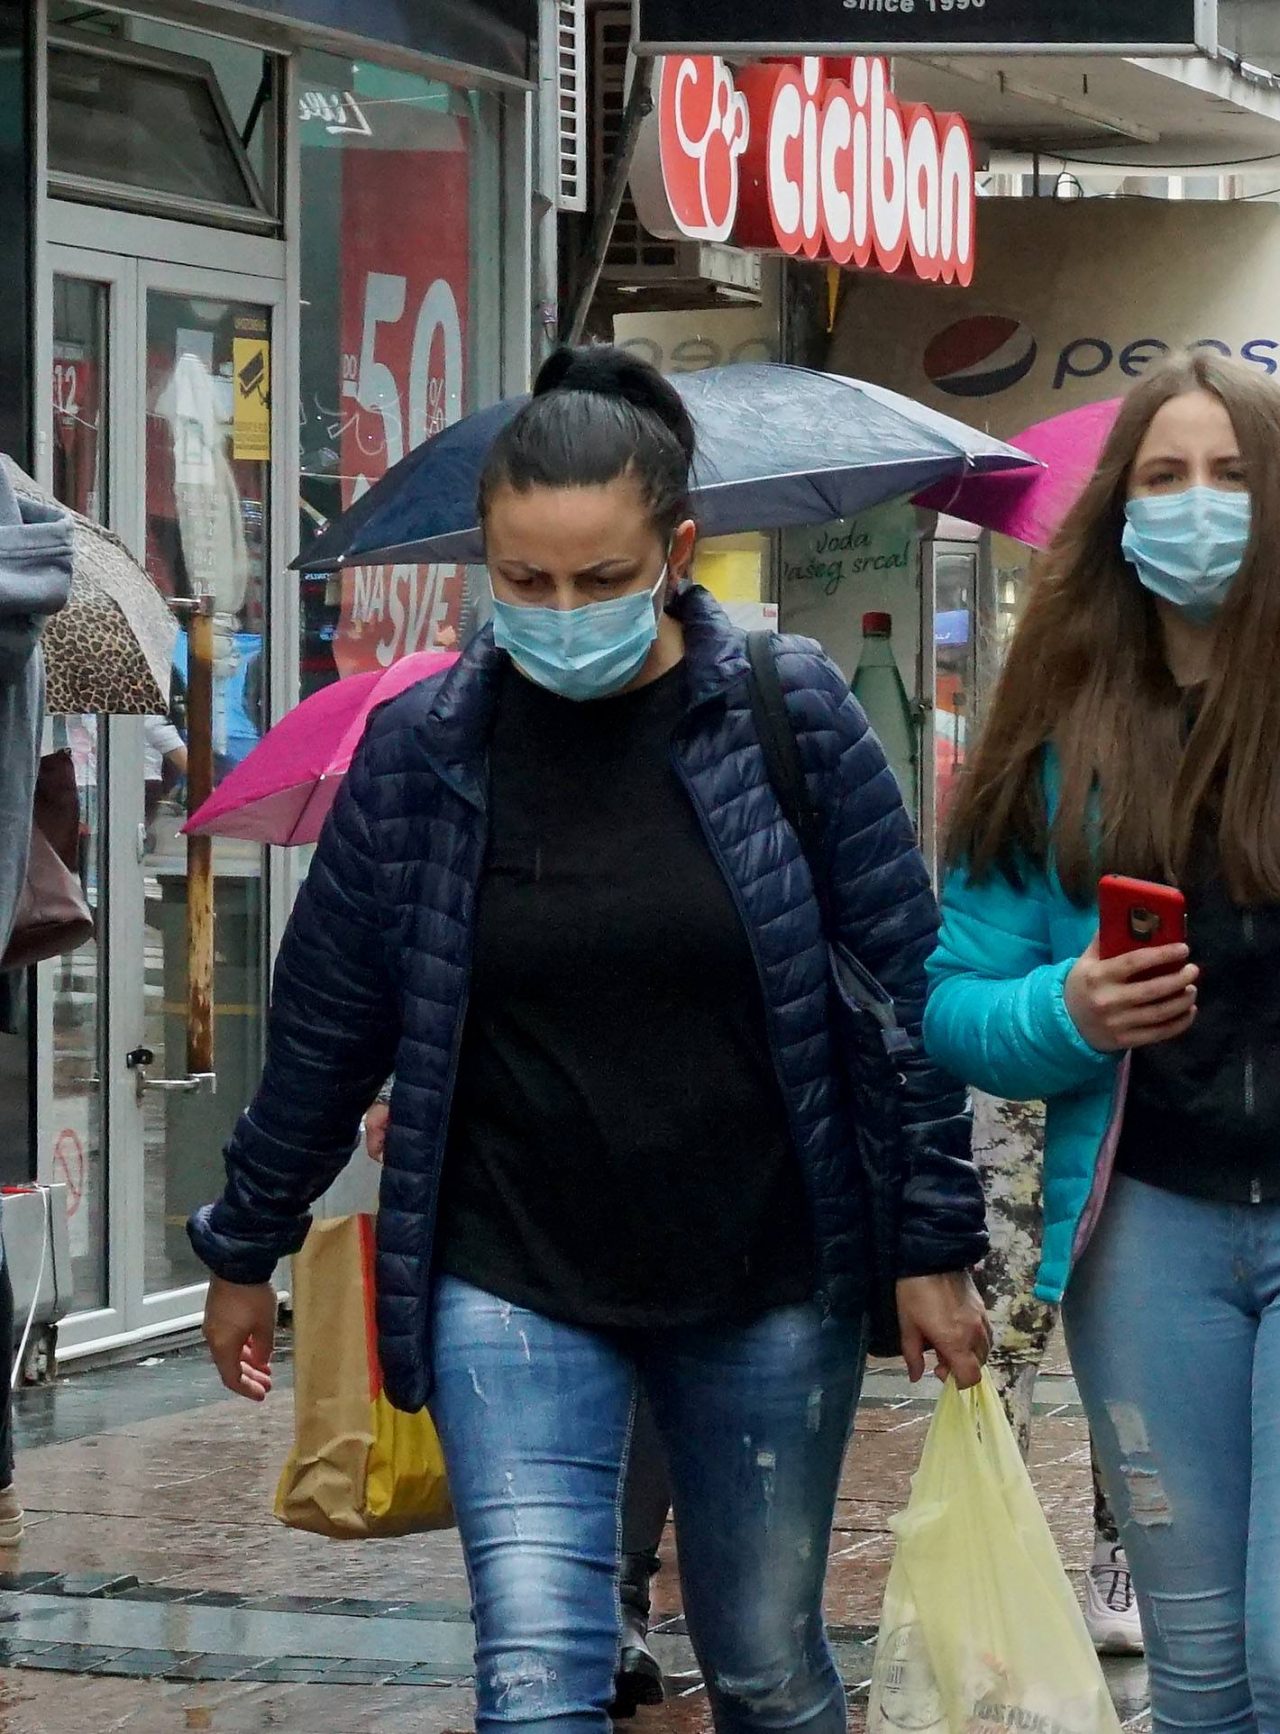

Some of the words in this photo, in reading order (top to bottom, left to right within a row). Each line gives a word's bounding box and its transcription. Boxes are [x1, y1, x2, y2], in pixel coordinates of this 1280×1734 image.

[769, 56, 971, 265] ciciban
[357, 271, 463, 468] 50
[351, 564, 384, 623] NA
[375, 564, 457, 667] SVE
